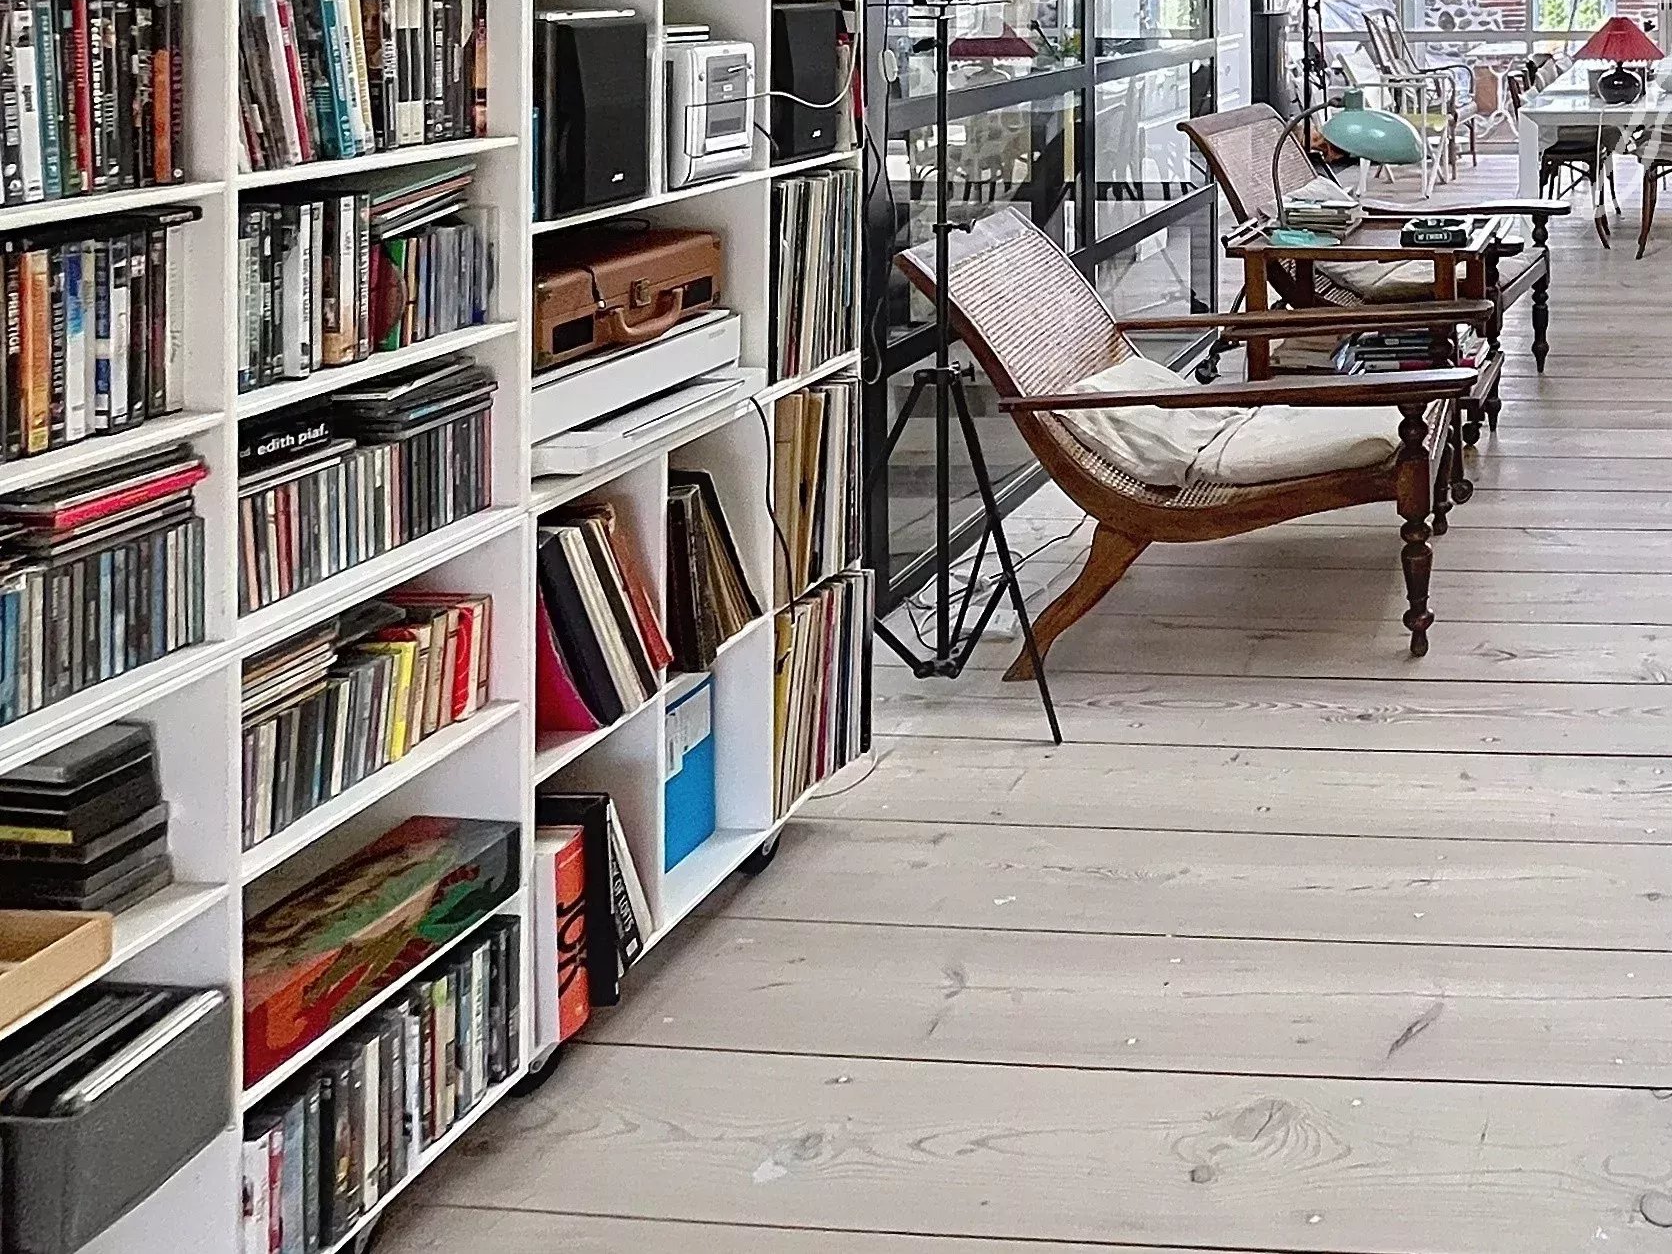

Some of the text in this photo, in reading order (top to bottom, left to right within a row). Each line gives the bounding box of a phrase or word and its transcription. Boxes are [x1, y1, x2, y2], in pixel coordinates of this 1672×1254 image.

[91, 18, 103, 55] Pedro
[7, 291, 19, 355] PRESTIGE
[257, 433, 295, 456] edith
[619, 897, 635, 933] LOFTS
